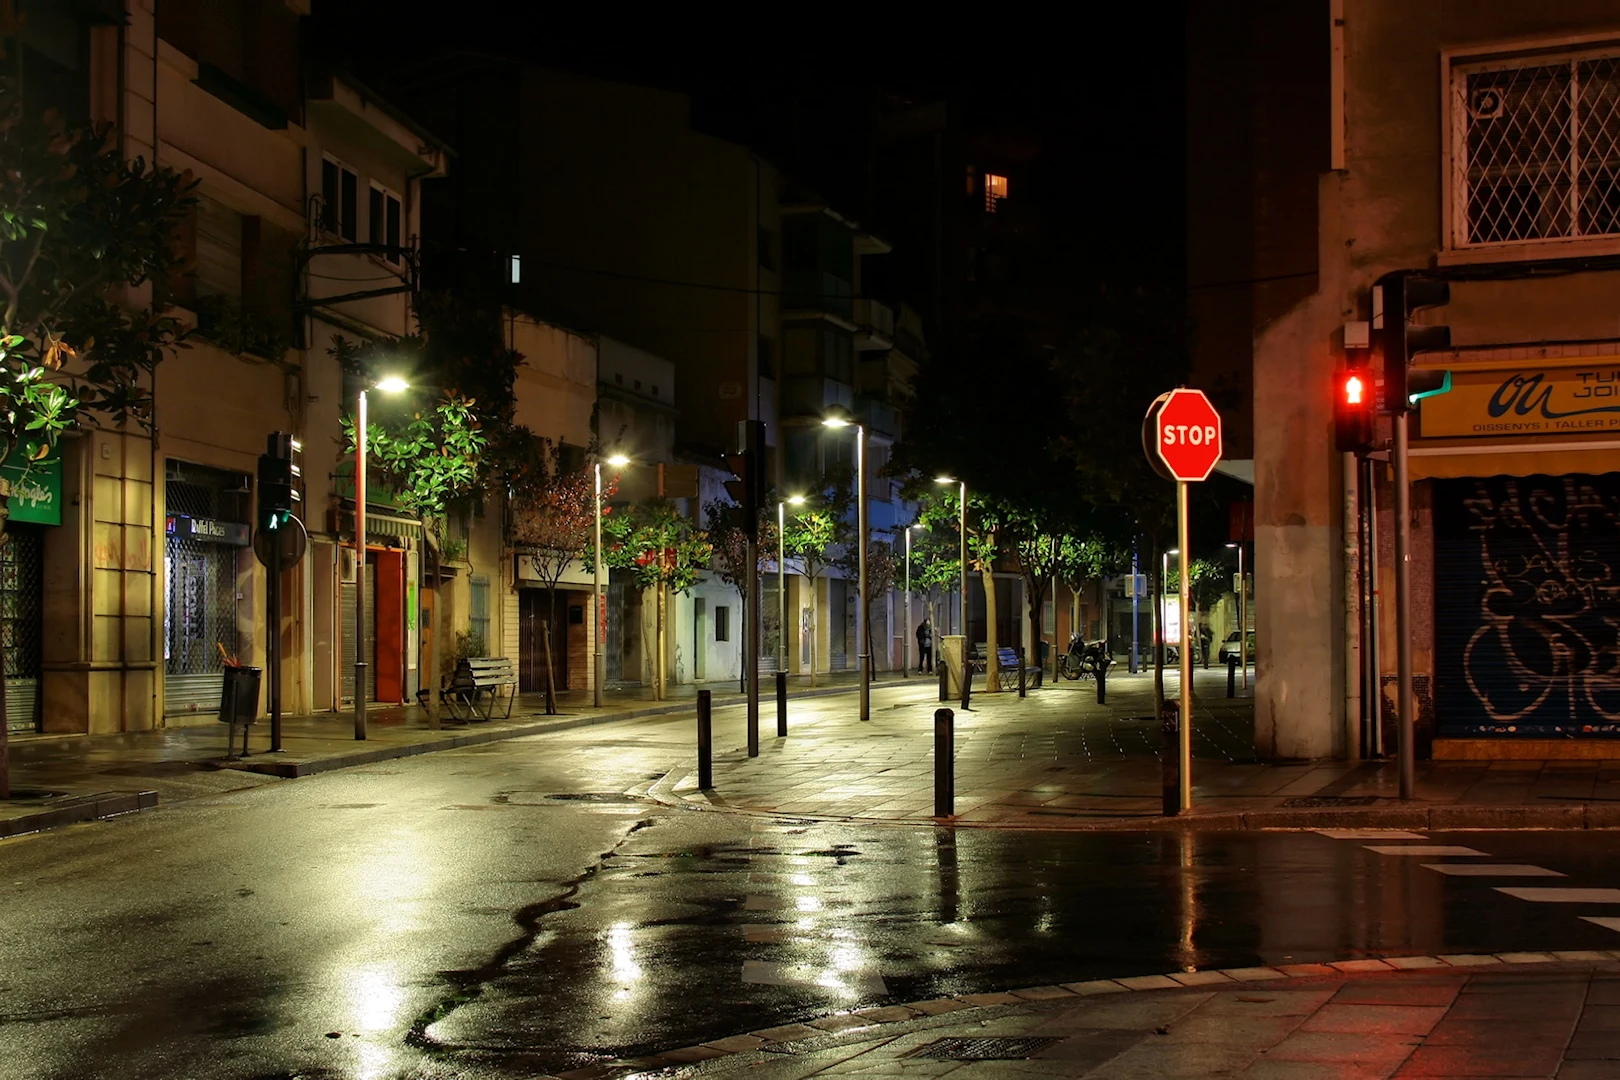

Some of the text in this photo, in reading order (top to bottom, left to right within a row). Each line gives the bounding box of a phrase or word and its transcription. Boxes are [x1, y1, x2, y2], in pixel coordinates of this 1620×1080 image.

[1576, 371, 1620, 384] TU
[1473, 422, 1540, 432] DISSENYS
[1554, 419, 1604, 429] TALLER
[1163, 424, 1216, 446] STOP
